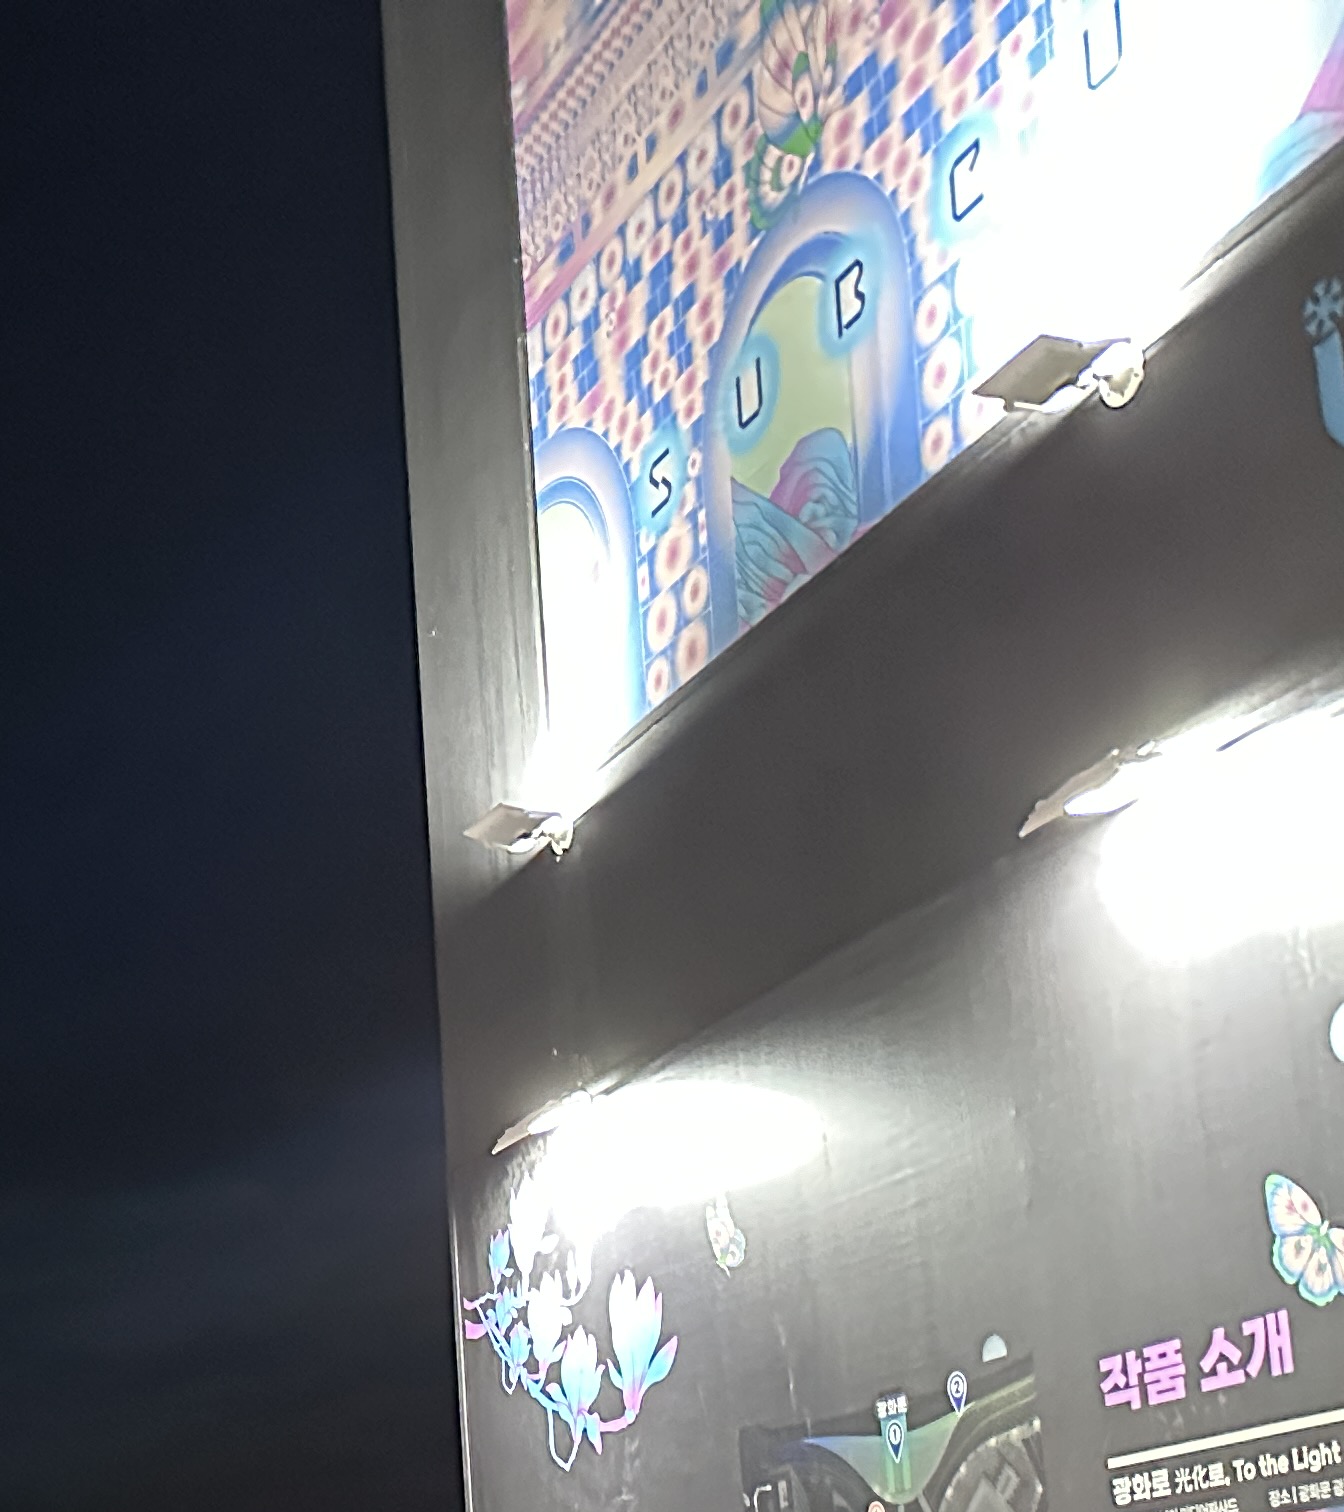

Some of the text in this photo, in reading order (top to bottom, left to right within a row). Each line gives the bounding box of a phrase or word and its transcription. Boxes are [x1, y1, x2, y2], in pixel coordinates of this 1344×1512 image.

[1098, 1307, 1295, 1411] 작품 소개
[1112, 1468, 1171, 1506] 광화로
[1232, 1459, 1256, 1482] To
[1258, 1453, 1290, 1475] the
[1291, 1439, 1342, 1472] Light
